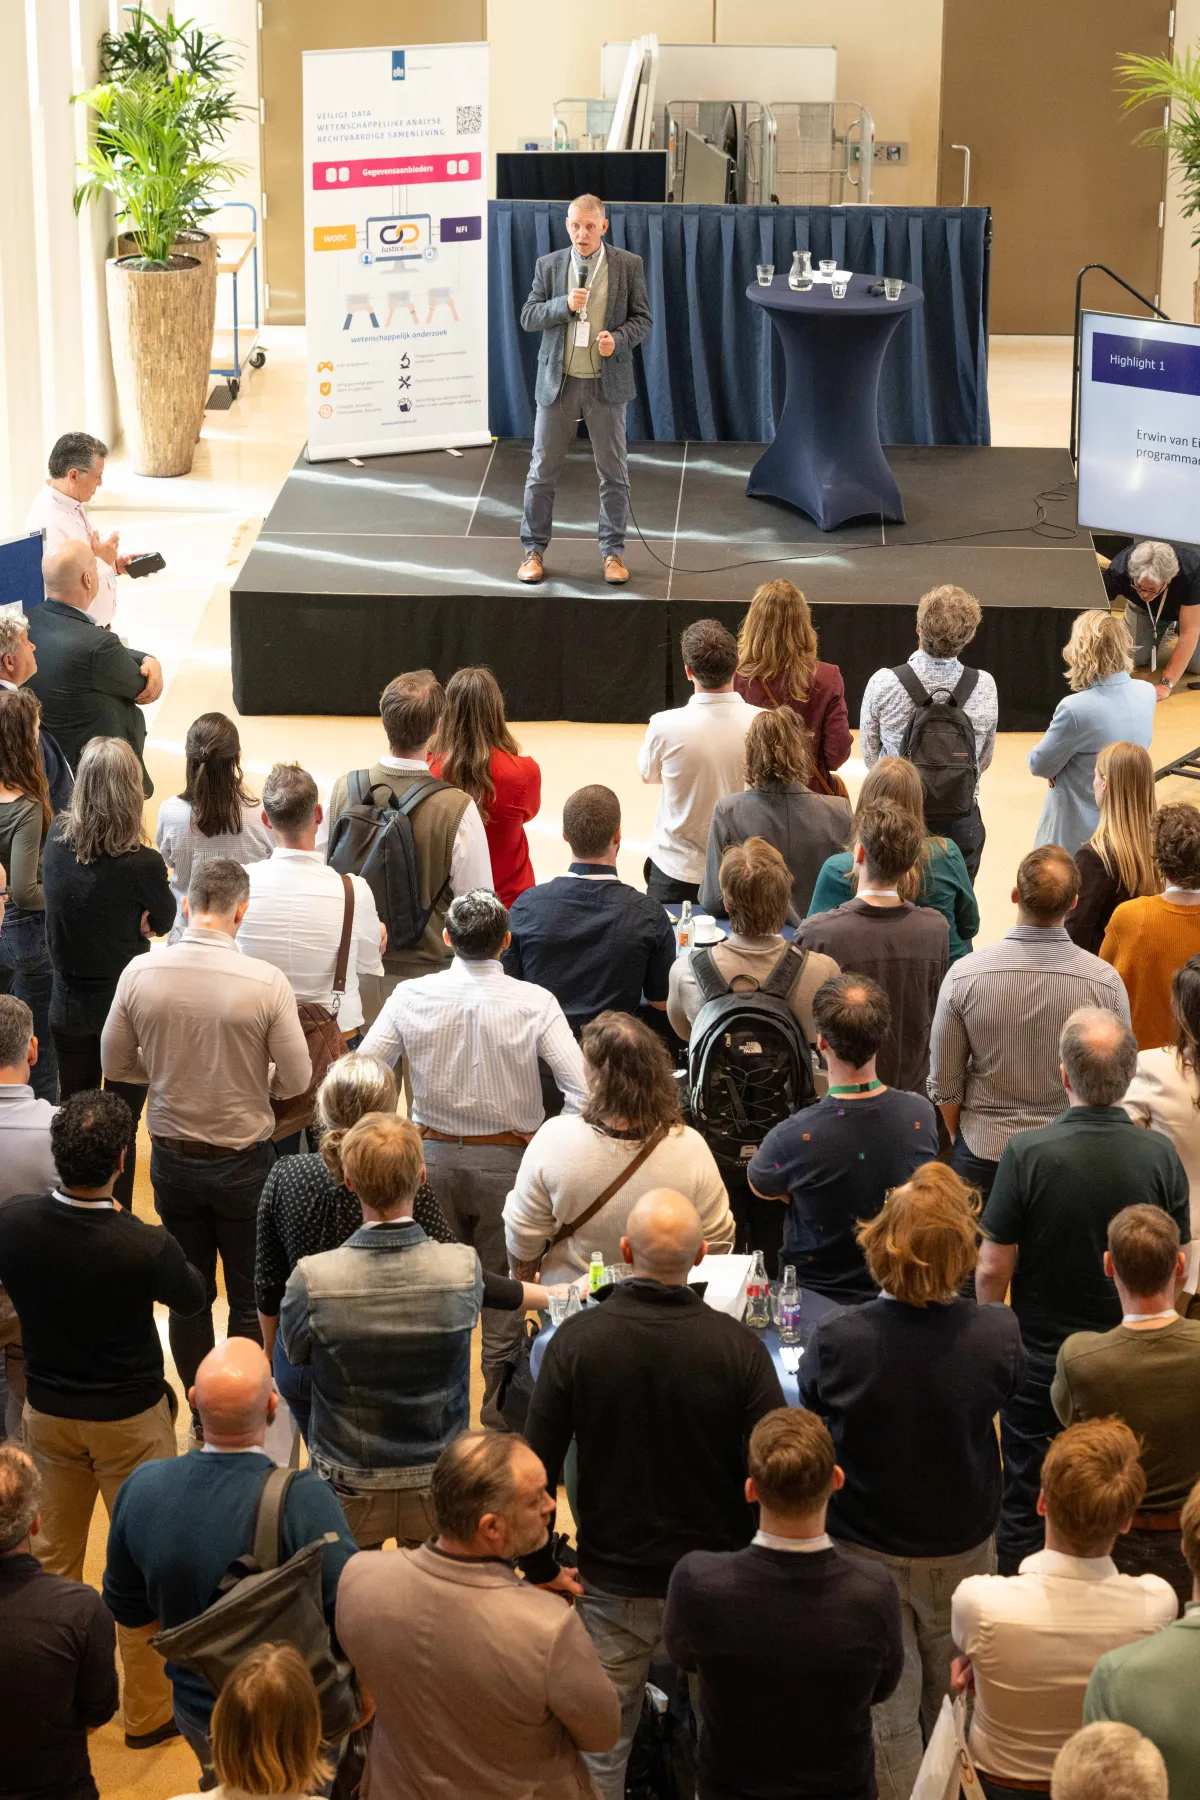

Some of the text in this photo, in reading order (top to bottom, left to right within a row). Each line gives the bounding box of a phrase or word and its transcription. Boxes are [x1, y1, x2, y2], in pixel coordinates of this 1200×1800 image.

[316, 109, 372, 120] VEILIGE DATA
[316, 117, 441, 131] WETENSCHAPPELIJKE ANALYSE
[316, 128, 445, 143] RECHTVAARDIGE SAMENLEVING
[362, 164, 434, 178] Gegevensaanbieders
[455, 225, 468, 234] NFI
[350, 329, 448, 343] wetenschappelijk onderzoek
[1110, 353, 1165, 371] Highlight 1
[1136, 428, 1167, 444] Erwin
[1169, 436, 1189, 447] van
